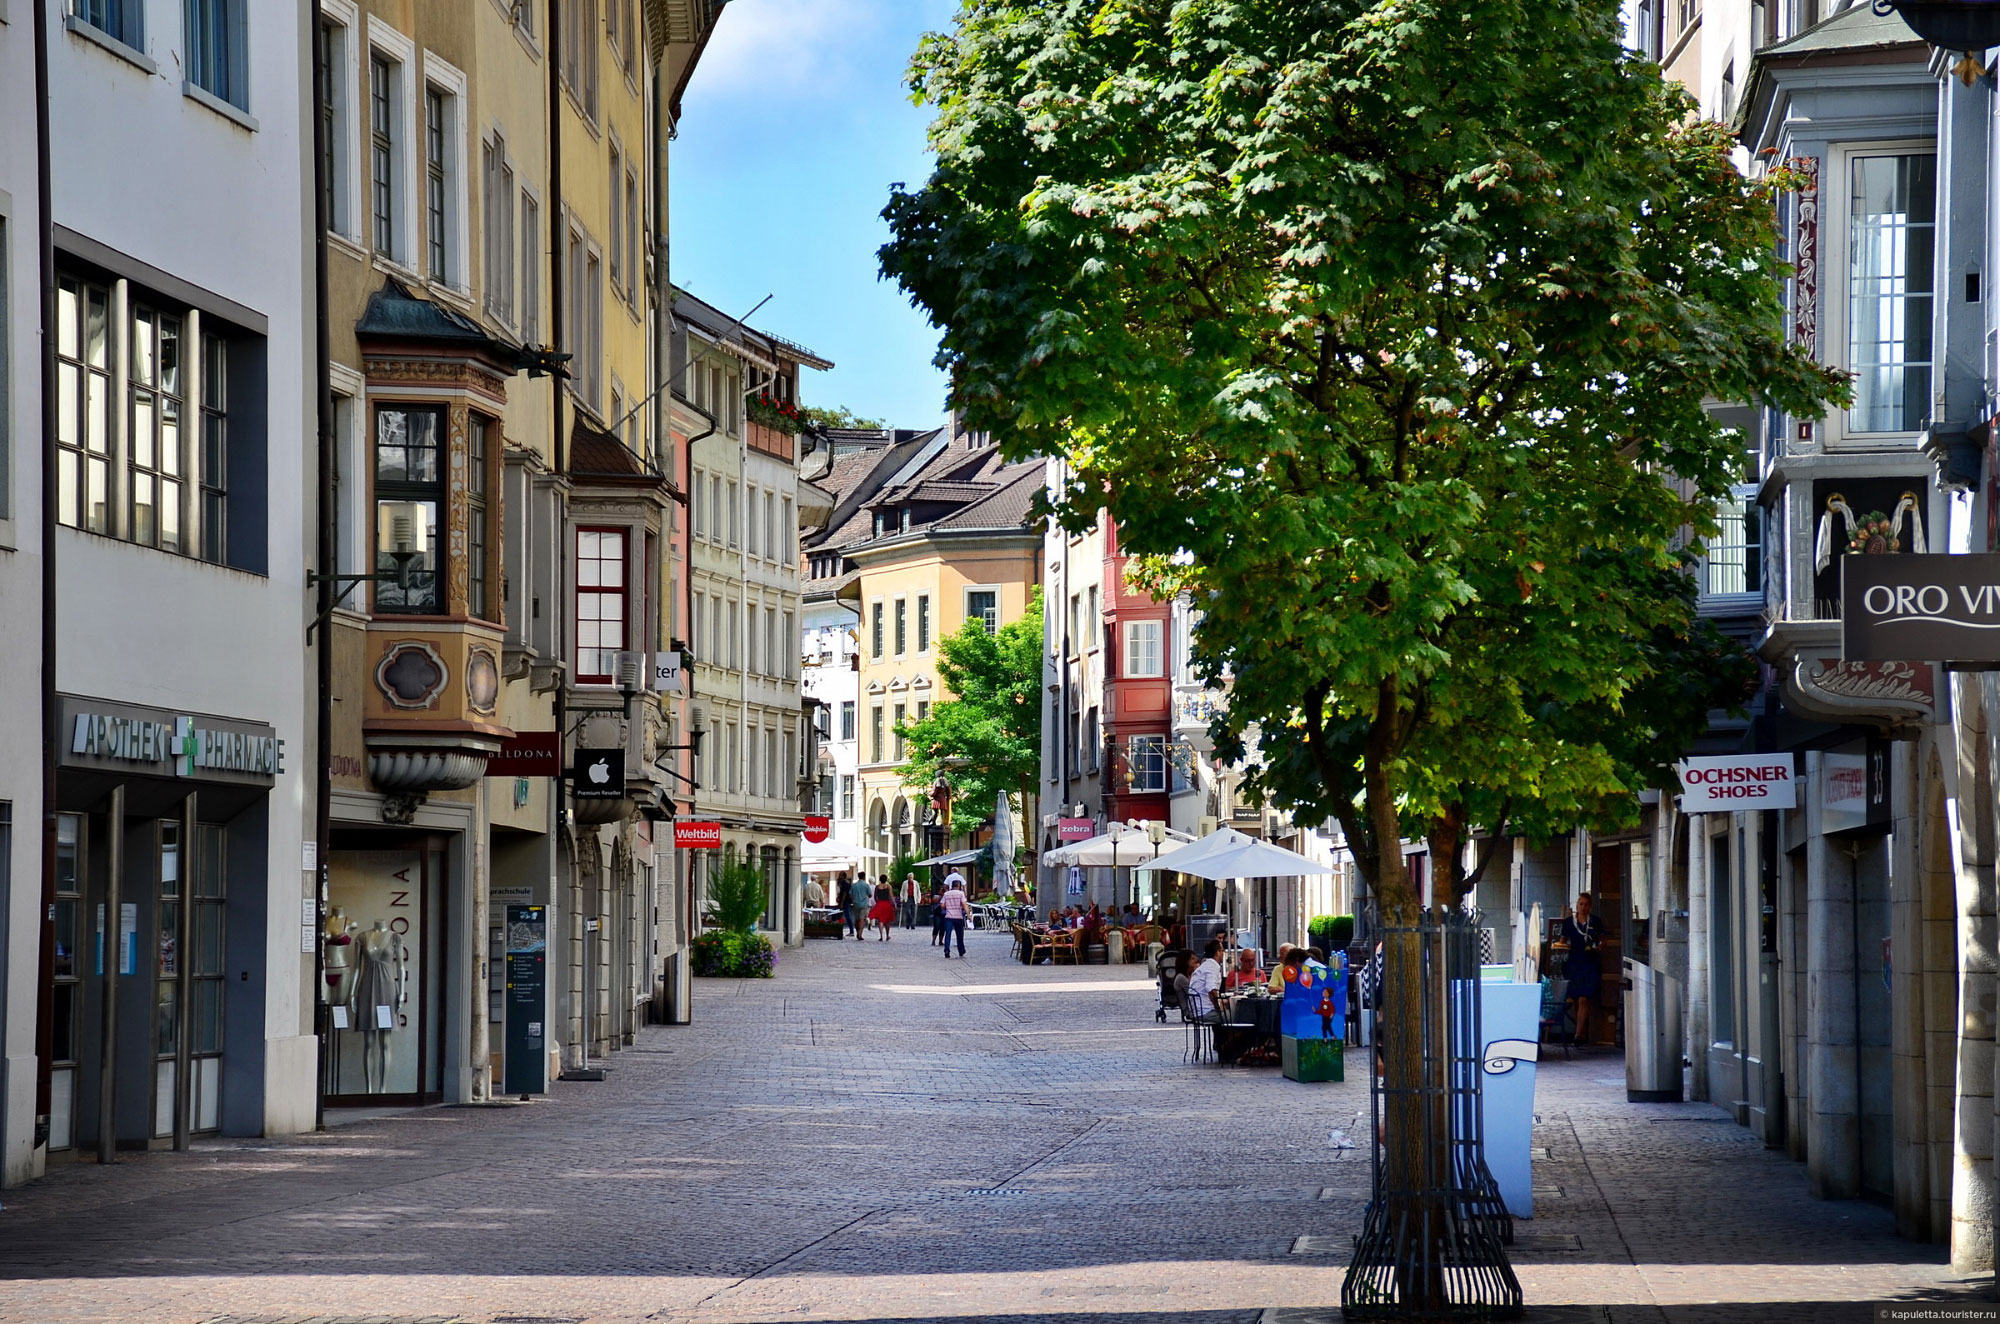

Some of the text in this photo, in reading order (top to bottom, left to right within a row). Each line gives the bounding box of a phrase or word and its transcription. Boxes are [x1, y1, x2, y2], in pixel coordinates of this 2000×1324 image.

[1864, 585, 2000, 615] ORO VI
[656, 665, 677, 679] ter
[195, 728, 285, 774] PHARMACIE
[488, 750, 553, 758] BELDONA
[1685, 766, 1789, 784] OCHSNER
[1708, 784, 1768, 799] SHOES
[676, 829, 719, 839] Weltbild
[1062, 825, 1090, 833] zebra
[490, 887, 531, 896] prachschule
